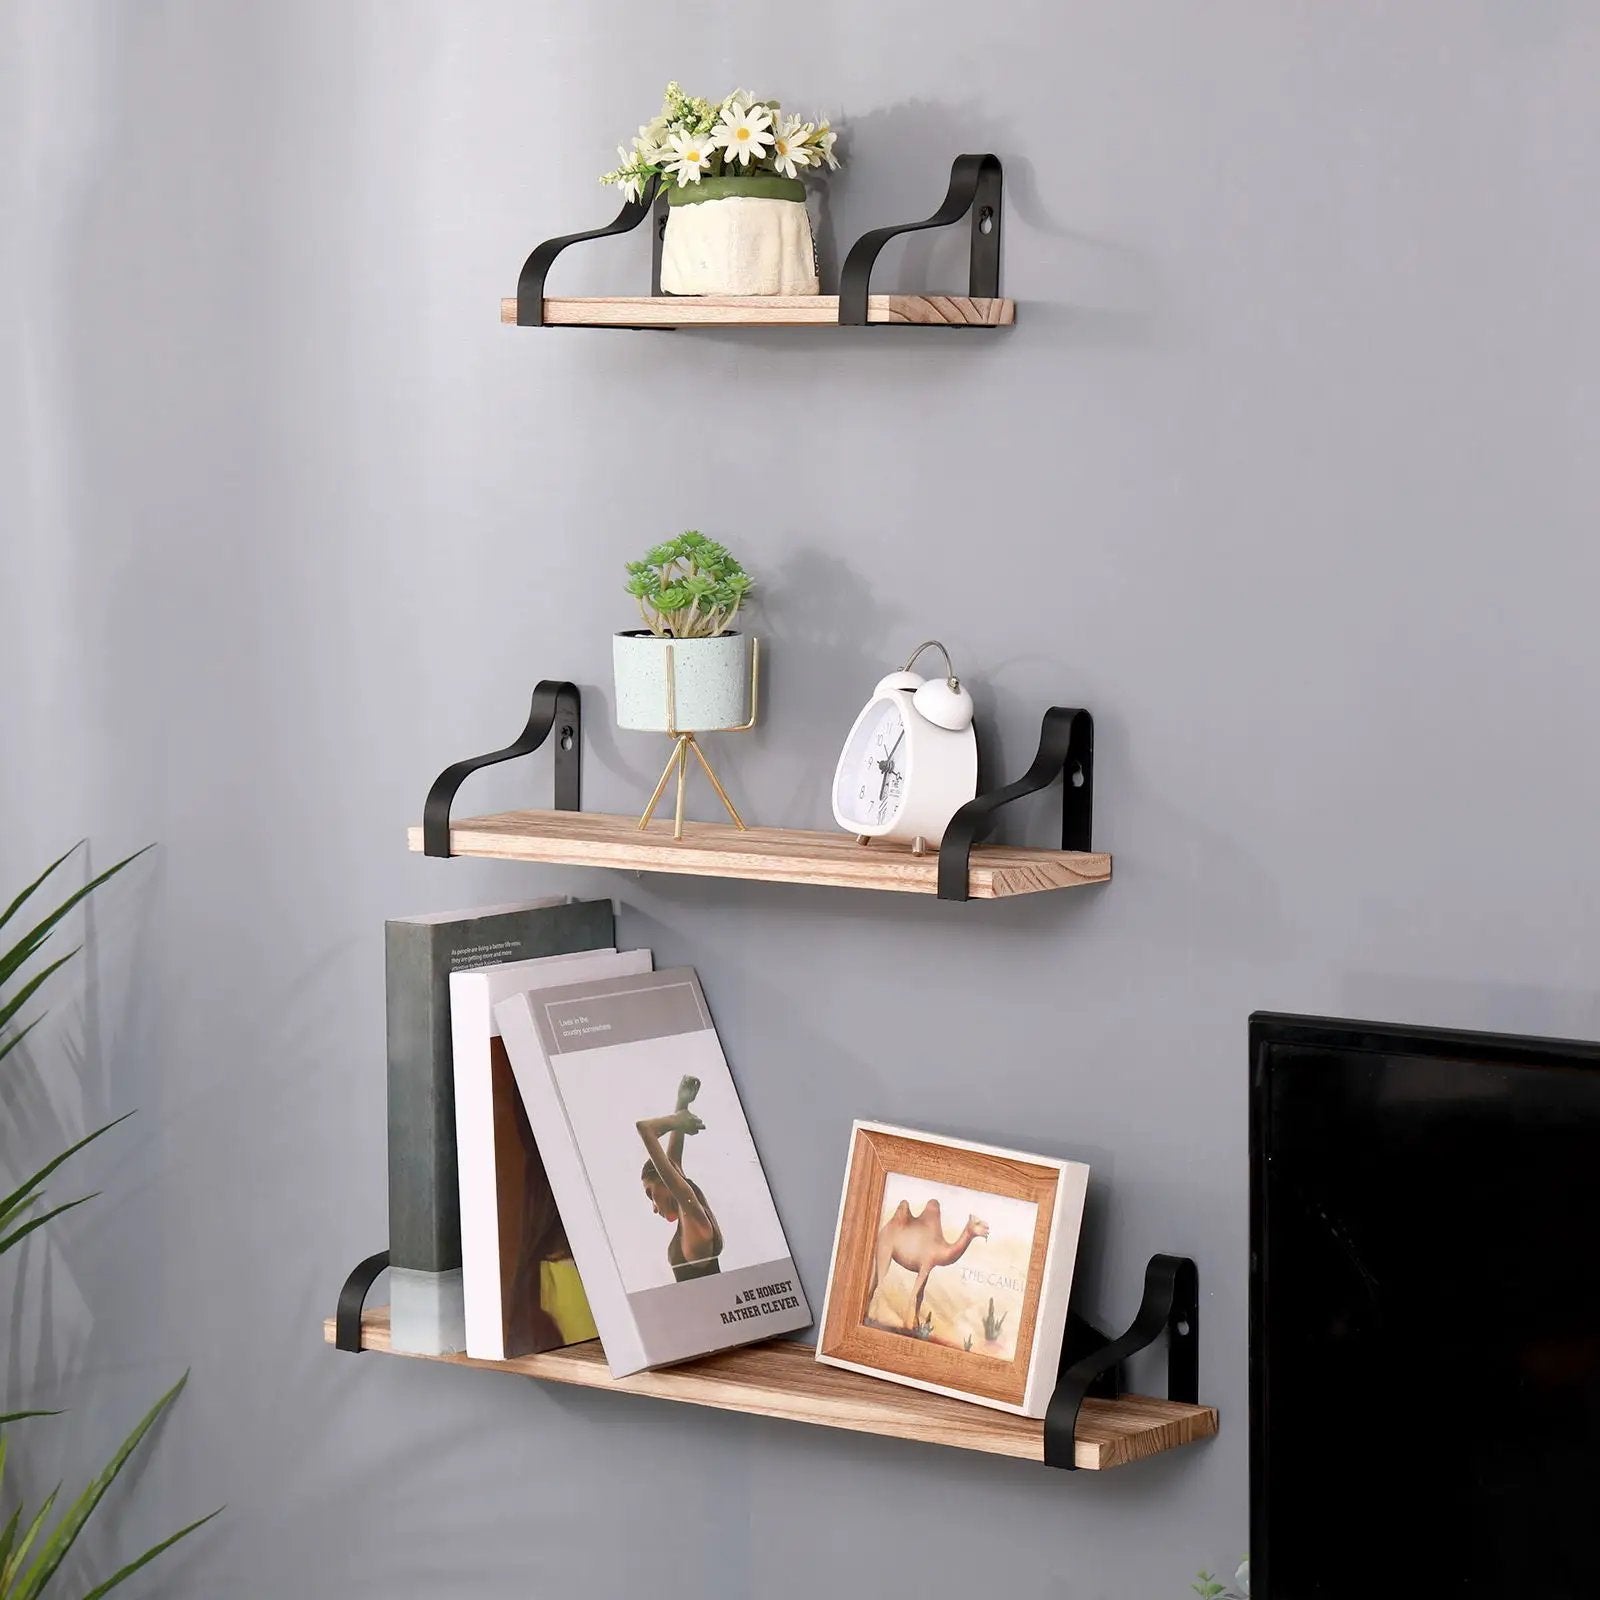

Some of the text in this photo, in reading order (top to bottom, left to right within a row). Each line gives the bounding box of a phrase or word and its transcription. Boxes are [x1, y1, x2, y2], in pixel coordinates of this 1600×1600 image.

[860, 785, 866, 799] 8
[868, 800, 875, 813] 7
[457, 947, 471, 956] people
[742, 1280, 793, 1302] BE HONEST
[720, 1296, 800, 1324] RATHER CLEVER
